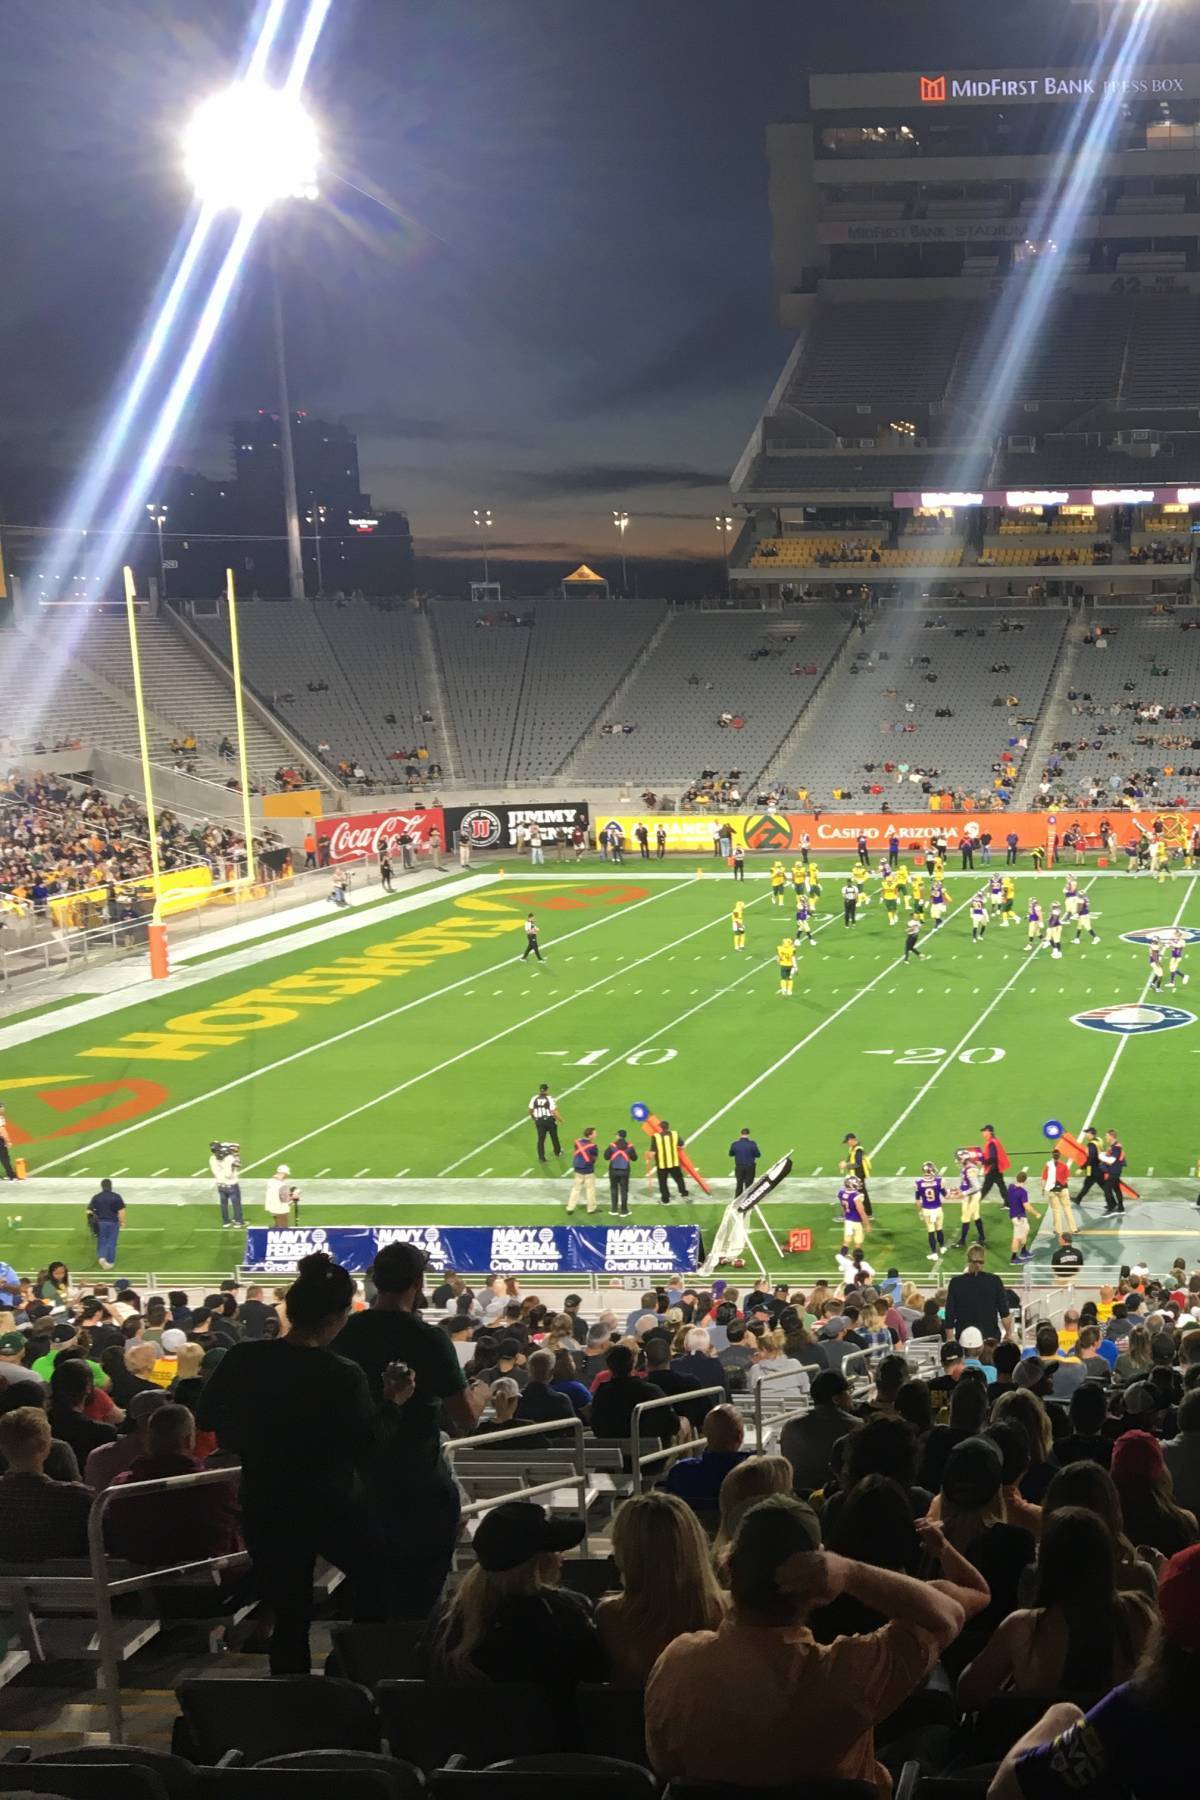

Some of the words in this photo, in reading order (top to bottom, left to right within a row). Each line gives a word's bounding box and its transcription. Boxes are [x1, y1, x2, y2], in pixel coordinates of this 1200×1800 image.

[1152, 78, 1184, 93] BOX
[1111, 277, 1141, 294] 42
[507, 809, 577, 828] JIMMY
[75, 916, 519, 1059] HOTSHOTS
[562, 1047, 679, 1066] 10
[893, 1047, 1006, 1065] 20
[924, 1187, 935, 1202] 9
[267, 1230, 311, 1244] NAVY
[378, 1228, 424, 1243] NAVY
[492, 1229, 538, 1242] NAVY
[606, 1229, 652, 1242] NAVY
[791, 1232, 809, 1248] 20
[491, 1241, 560, 1255] FEDERAL
[605, 1241, 674, 1255] FEDERAL
[489, 1259, 524, 1272] Credit
[526, 1259, 559, 1272] Union
[604, 1259, 638, 1272] Credit
[640, 1259, 673, 1272] Union
[630, 1277, 645, 1289] 31
